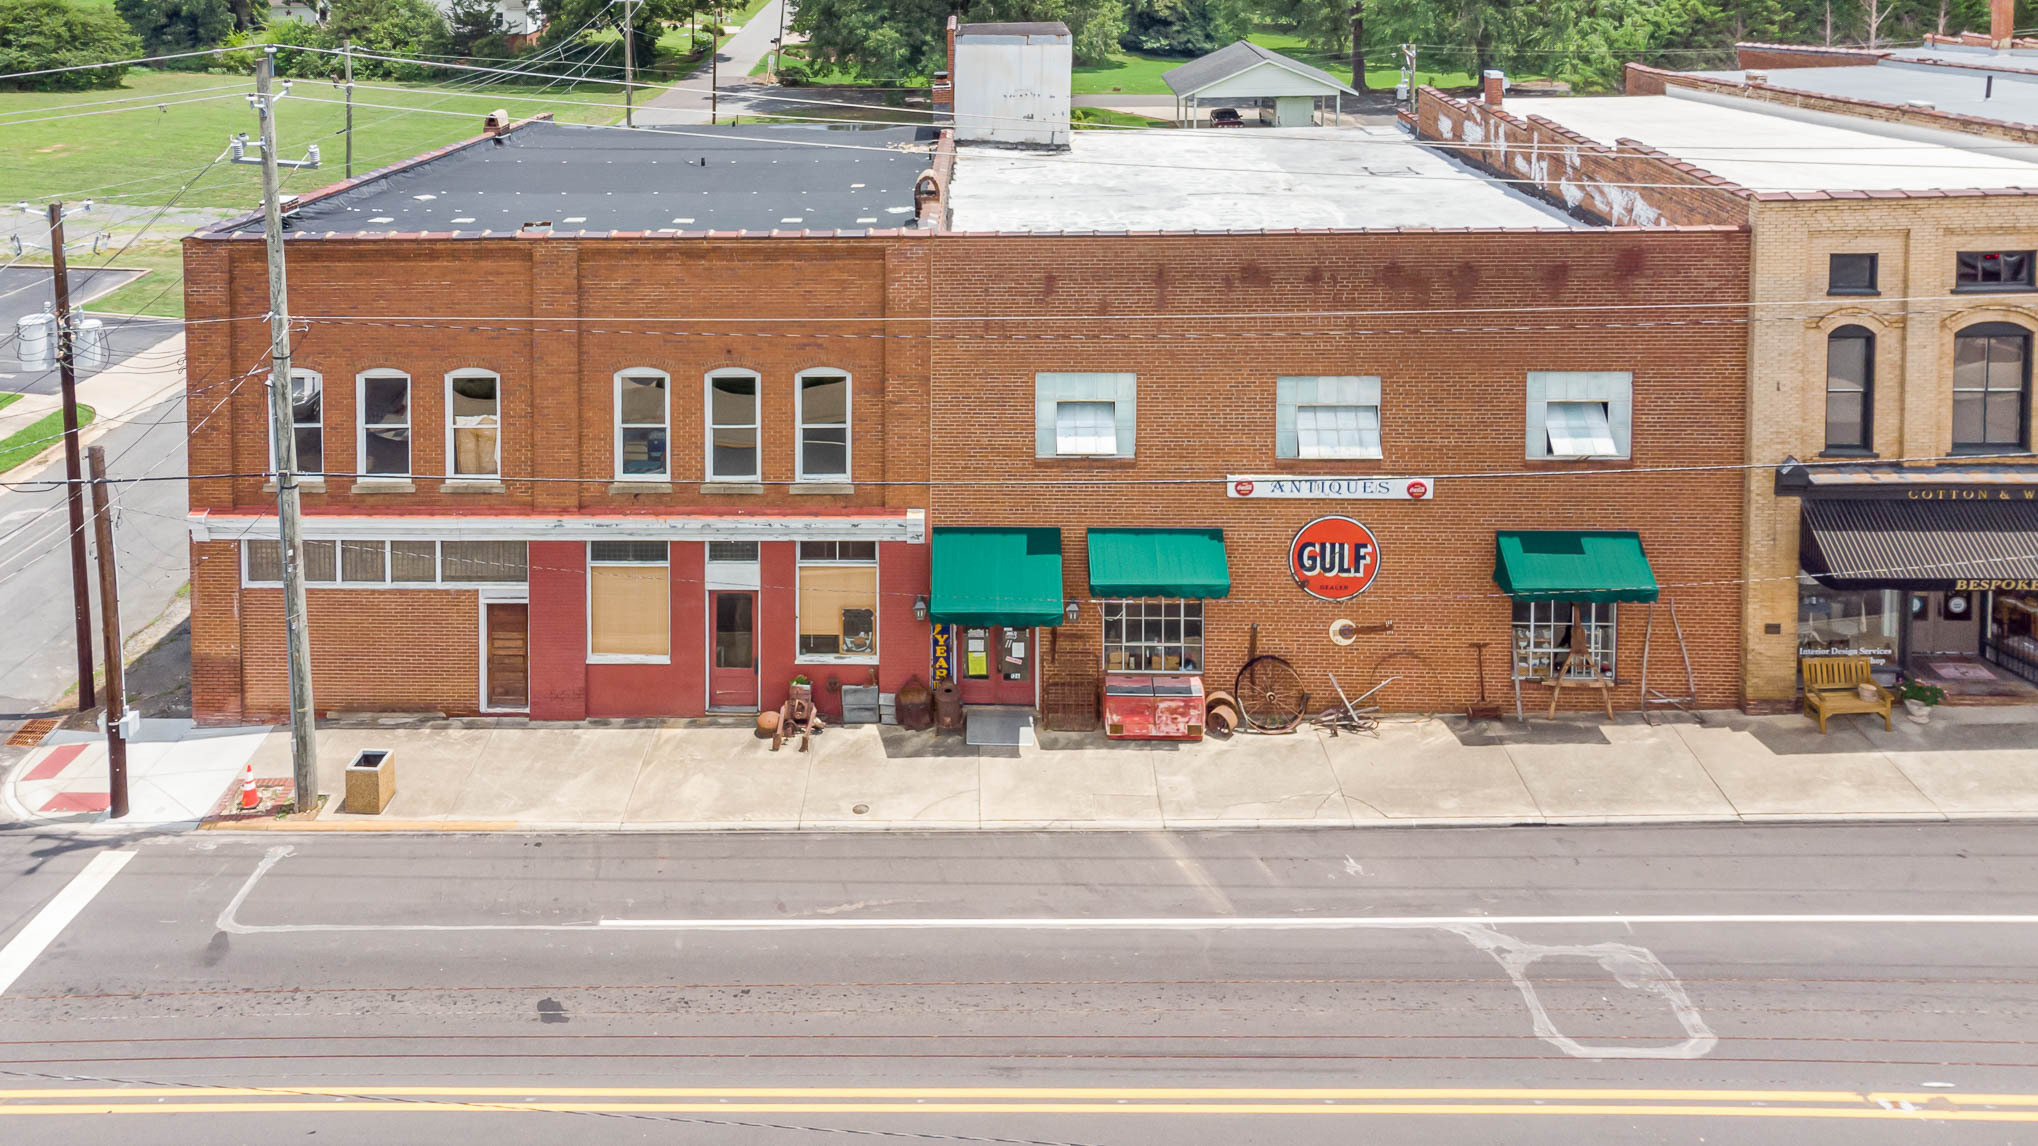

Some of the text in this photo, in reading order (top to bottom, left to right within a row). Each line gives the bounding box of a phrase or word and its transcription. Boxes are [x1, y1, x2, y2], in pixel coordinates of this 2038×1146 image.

[1271, 480, 1390, 494] ANTIQUES
[1908, 489, 1988, 499] COTTON
[2000, 489, 2010, 499] &
[1297, 542, 1373, 577] GULF
[1800, 647, 1892, 656] Interior Design Services
[1869, 656, 1886, 666] hop
